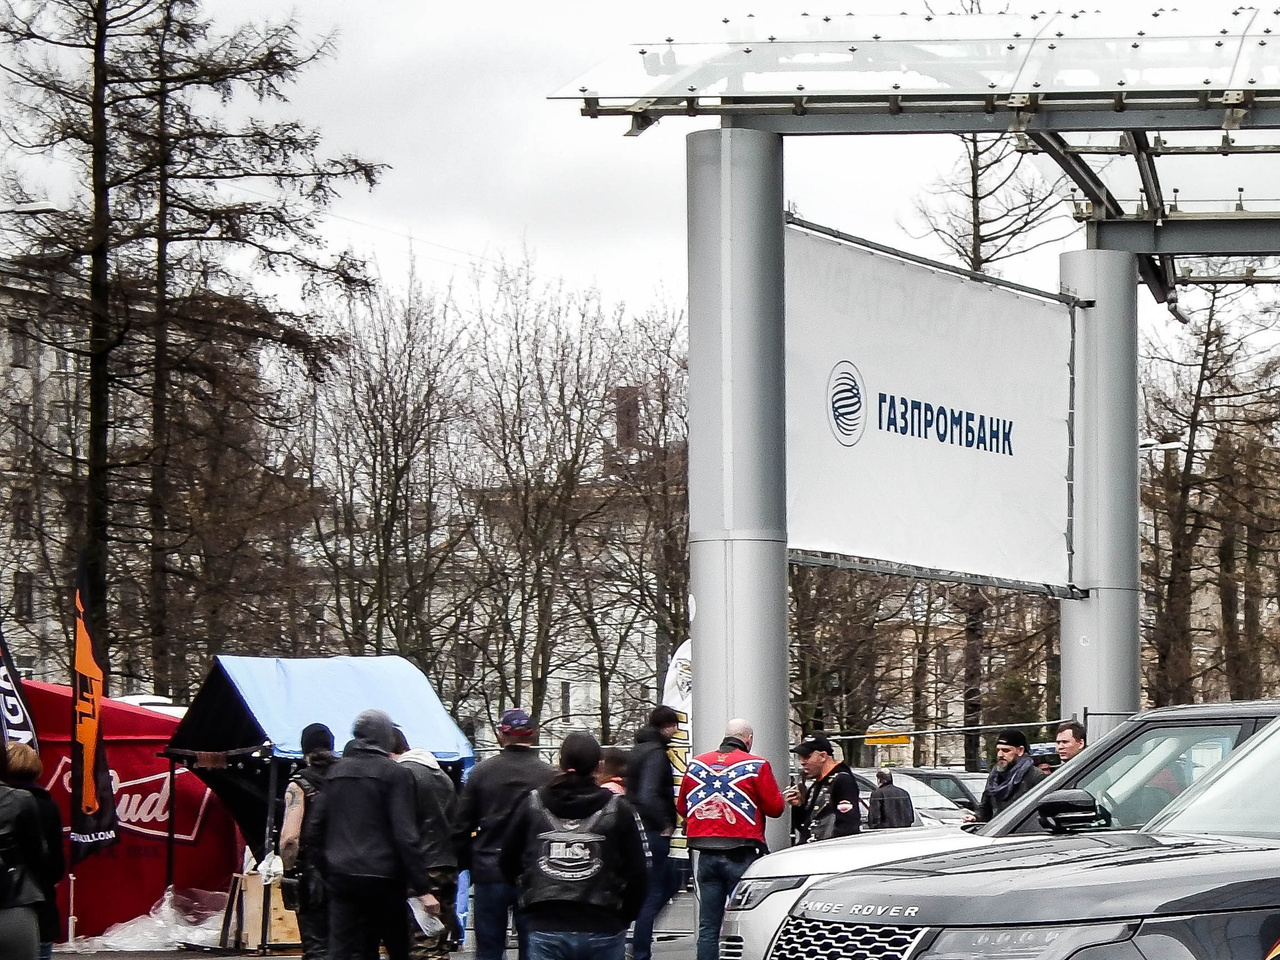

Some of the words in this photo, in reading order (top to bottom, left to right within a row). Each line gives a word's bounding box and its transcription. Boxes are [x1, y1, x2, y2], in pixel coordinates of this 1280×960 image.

[878, 392, 1014, 456] ГАЗПРОМБАНК
[800, 901, 844, 914] RANGE
[849, 904, 919, 917] ROVER
